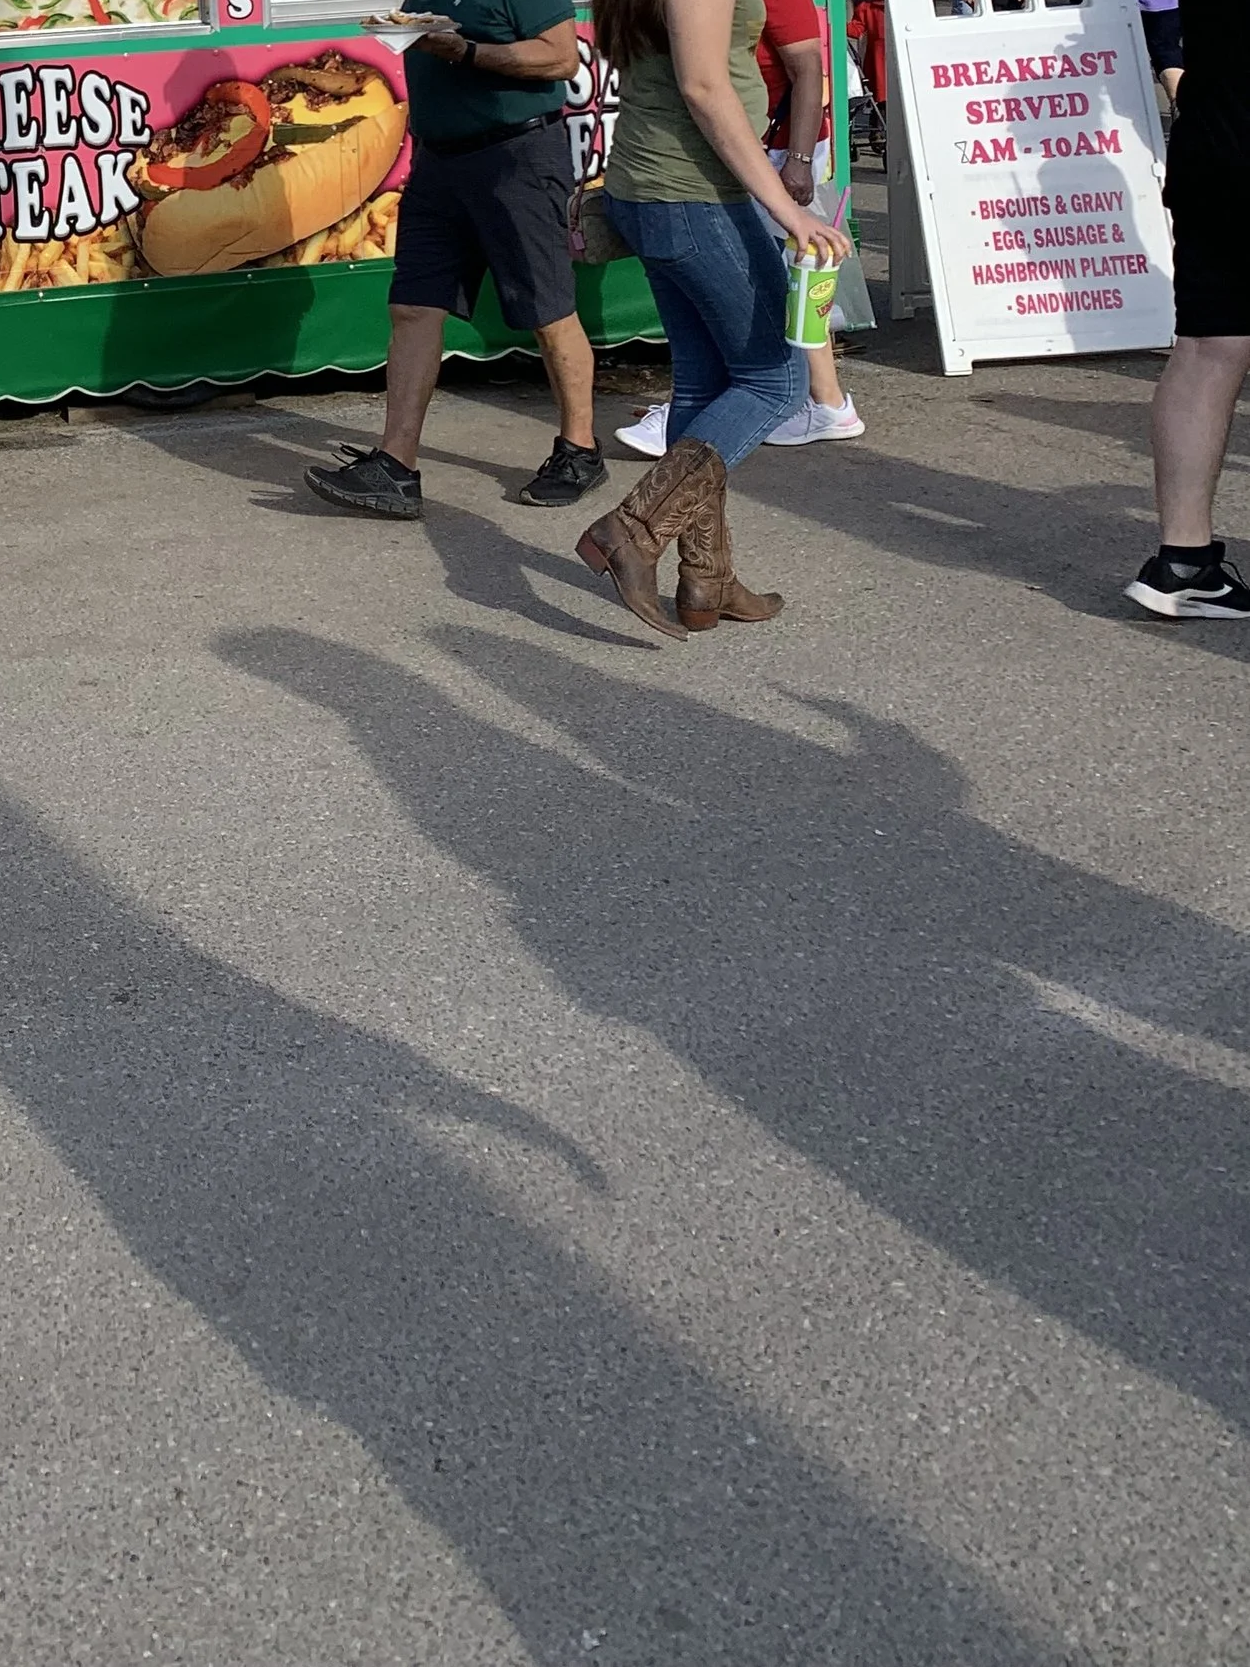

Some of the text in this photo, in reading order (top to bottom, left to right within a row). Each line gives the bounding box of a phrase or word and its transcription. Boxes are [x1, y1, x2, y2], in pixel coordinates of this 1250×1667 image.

[931, 50, 1118, 89] BREAKFAST
[966, 92, 1089, 125] SERVED
[1040, 130, 1123, 159] 10AM
[979, 191, 1124, 220] BISCUITS & GRAVY
[992, 223, 1125, 254] EGG, SAUSAGE &
[973, 254, 1148, 286] HASHBROWN PLATTER
[1016, 289, 1123, 315] SANDWICHES
